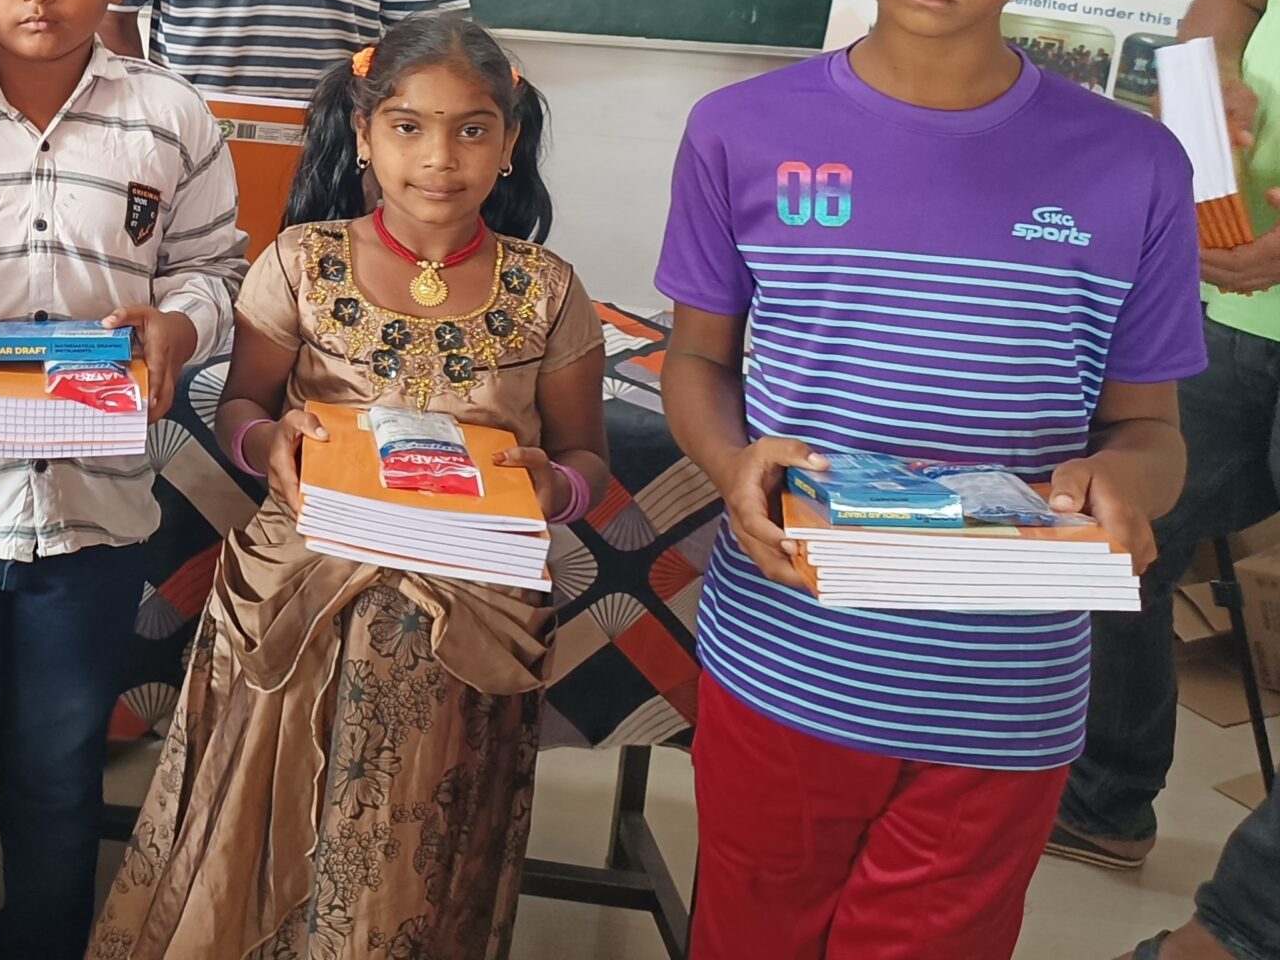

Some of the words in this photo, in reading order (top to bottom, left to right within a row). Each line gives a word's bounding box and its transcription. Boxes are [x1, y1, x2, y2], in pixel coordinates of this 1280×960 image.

[1082, 4, 1135, 21] under
[1139, 12, 1171, 26] this
[776, 161, 853, 228] 08
[1011, 222, 1092, 247] sports
[14, 346, 48, 355] DRAFT
